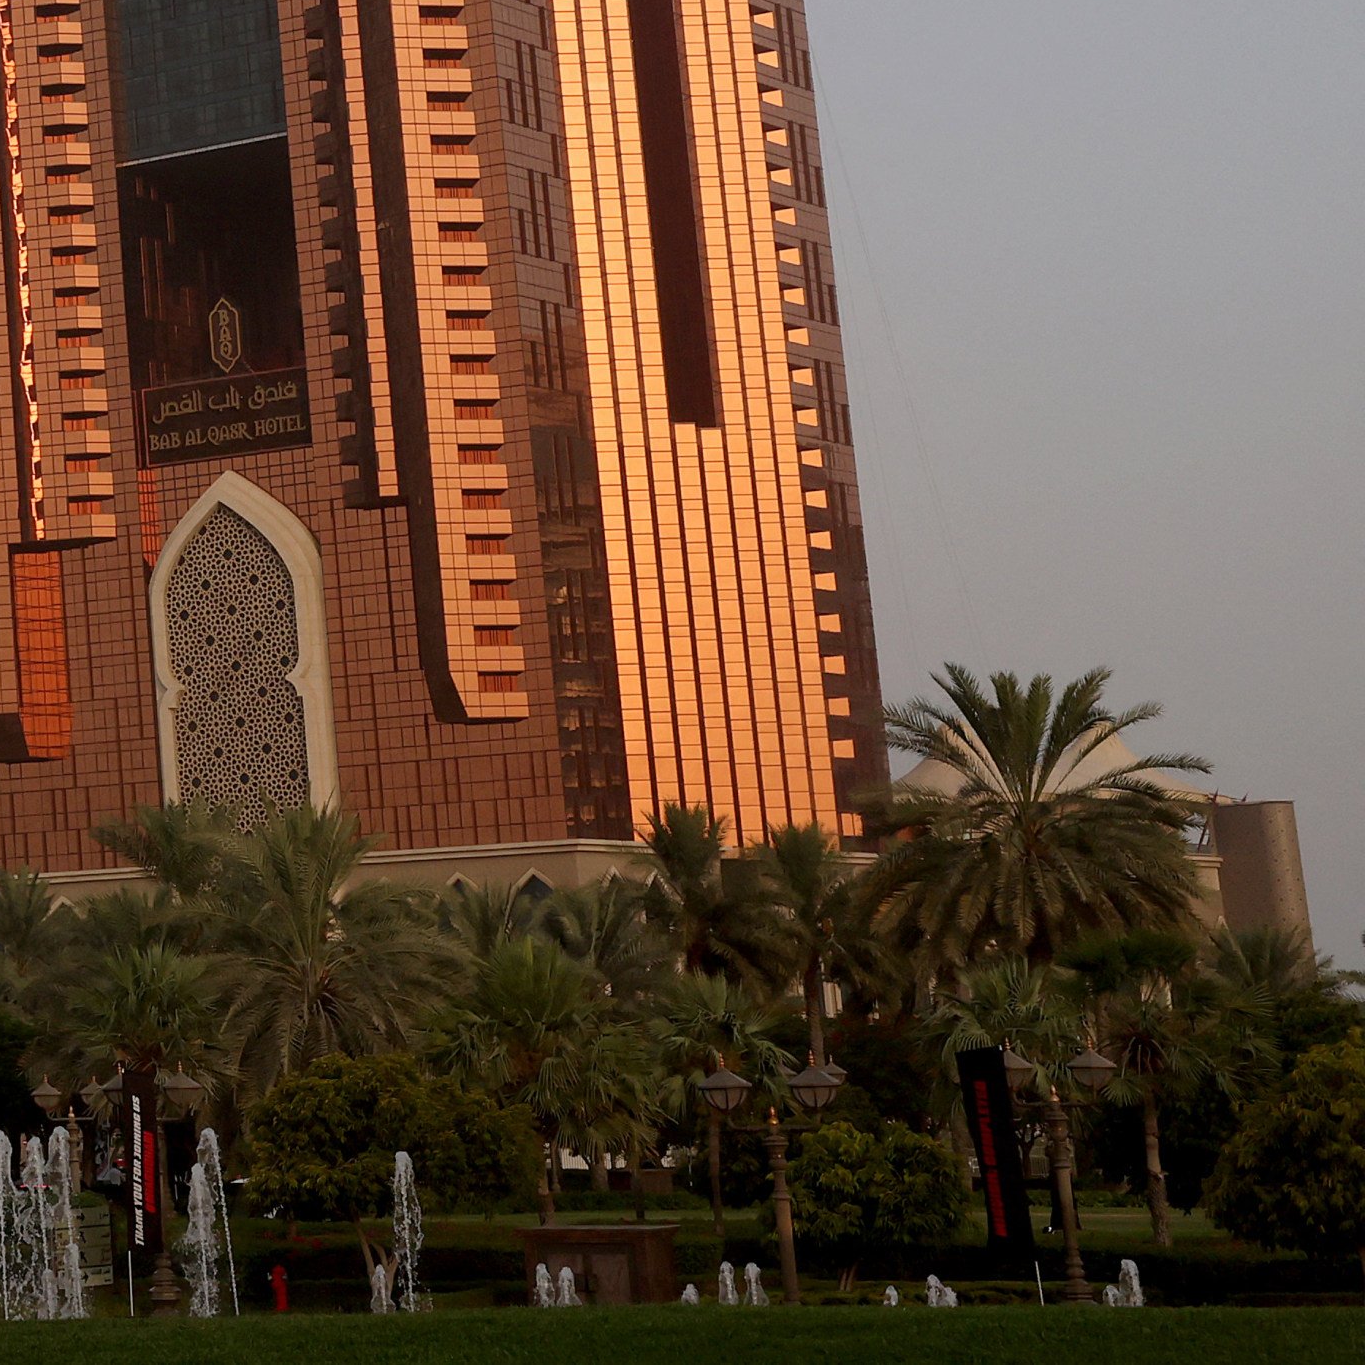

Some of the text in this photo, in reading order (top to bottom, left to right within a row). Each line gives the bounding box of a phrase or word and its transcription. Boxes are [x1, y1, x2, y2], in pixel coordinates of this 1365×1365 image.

[219, 310, 234, 360] BAQ
[152, 381, 297, 424] فندق باب القصر
[149, 433, 181, 451] BAB
[254, 414, 306, 436] HOTEL
[132, 1095, 145, 1246] THANK YOU FOR JOINING US
